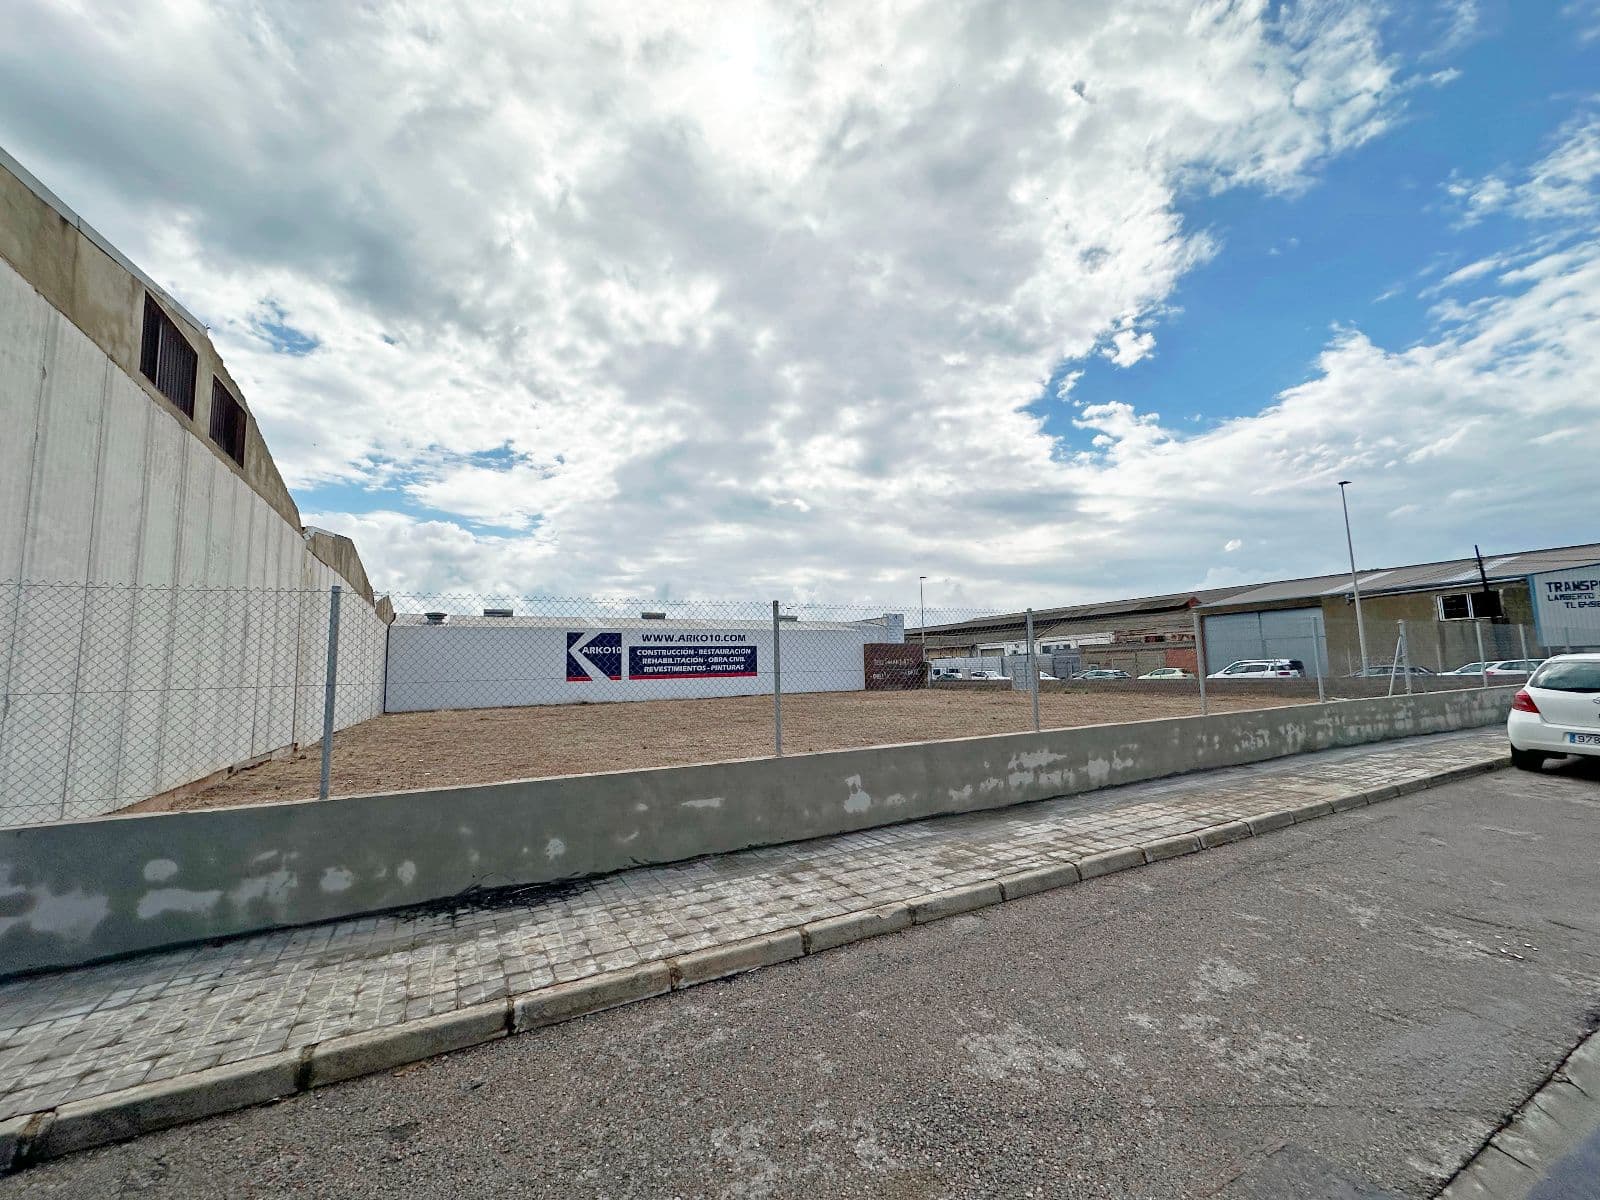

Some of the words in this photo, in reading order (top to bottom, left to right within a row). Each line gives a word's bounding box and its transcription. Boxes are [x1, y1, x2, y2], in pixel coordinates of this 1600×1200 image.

[1545, 580, 1600, 592] TRANSP
[642, 634, 746, 643] WWW.ARKO10.COM
[581, 646, 622, 655] ARKO10
[636, 648, 694, 656] CONSTRUCCIÓN
[698, 647, 751, 655] RESTAURACIÓN
[642, 656, 704, 665] REHABILITACIÓN
[708, 656, 728, 664] OBRA
[729, 655, 746, 663] CIVIL
[643, 665, 706, 673] REVESTIMIENTOS
